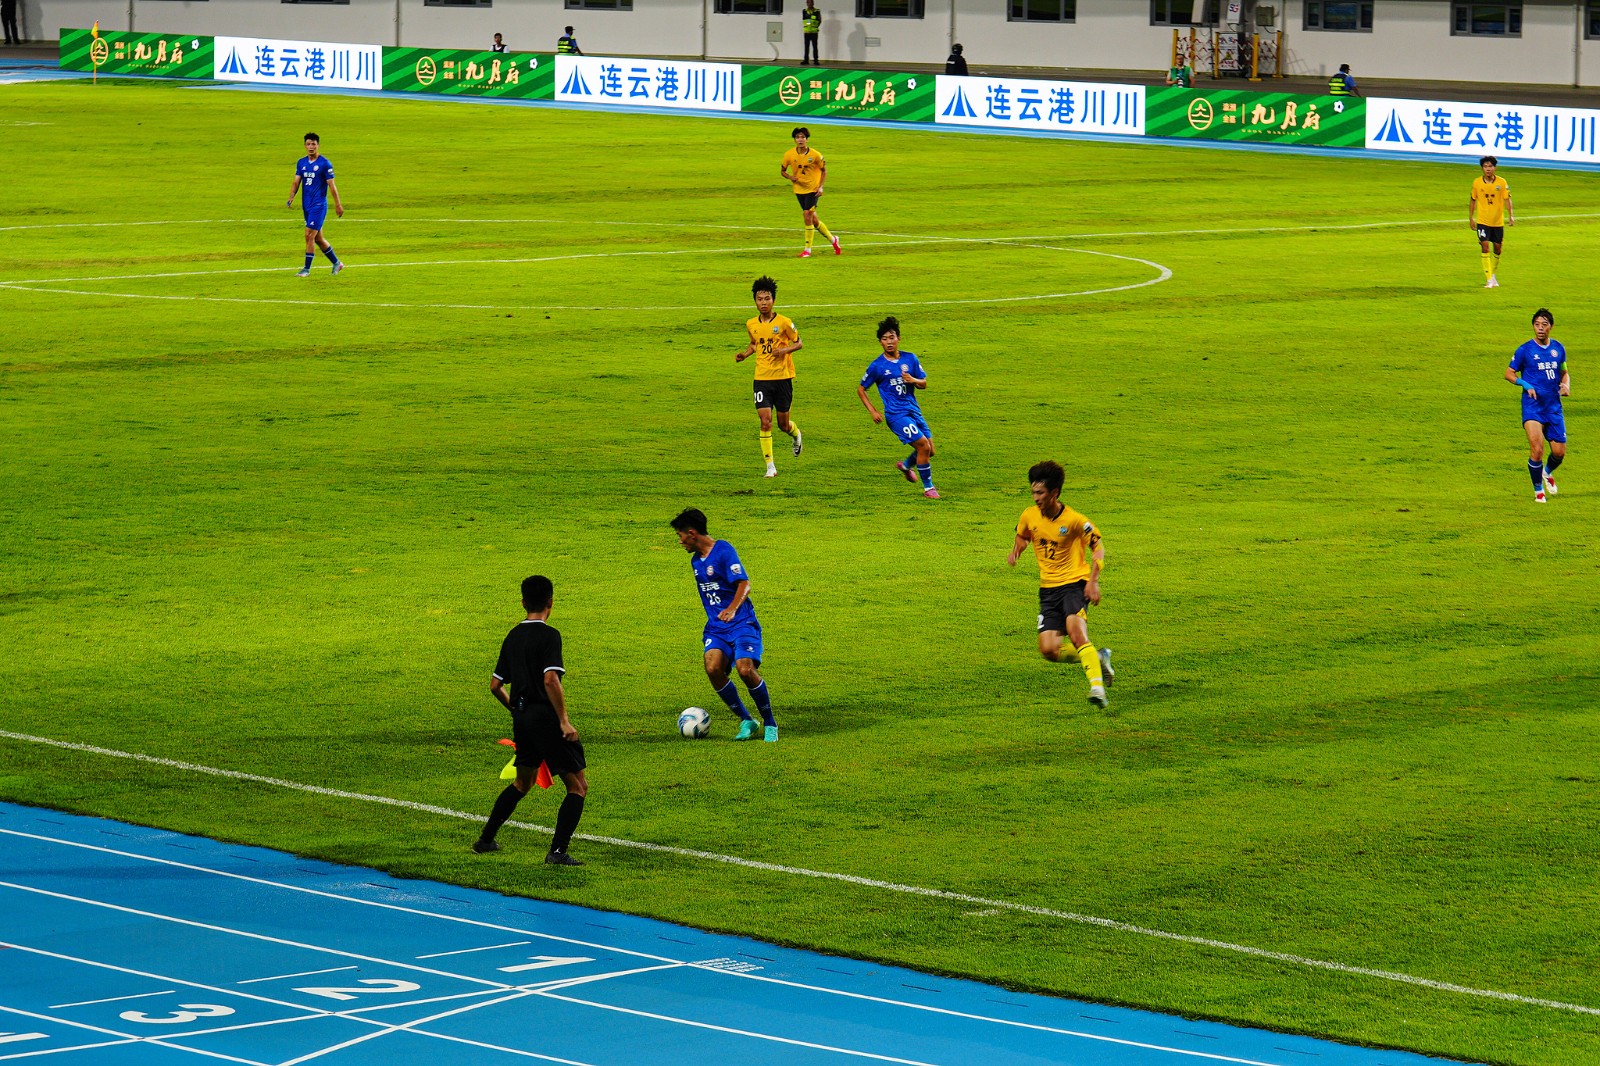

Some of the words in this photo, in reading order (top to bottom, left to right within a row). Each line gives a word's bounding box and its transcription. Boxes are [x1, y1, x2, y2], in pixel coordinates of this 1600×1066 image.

[254, 45, 376, 83] 连云港川川
[599, 63, 735, 105] 连云港川川
[984, 84, 1138, 128] 连云港川川
[1422, 107, 1596, 155] 连云港川川
[761, 344, 773, 355] 20
[1545, 369, 1556, 380] 10
[754, 391, 764, 404] 0
[903, 423, 919, 438] 90
[1044, 547, 1056, 560] 12
[292, 978, 421, 1002] 2
[118, 1002, 236, 1025] 3
